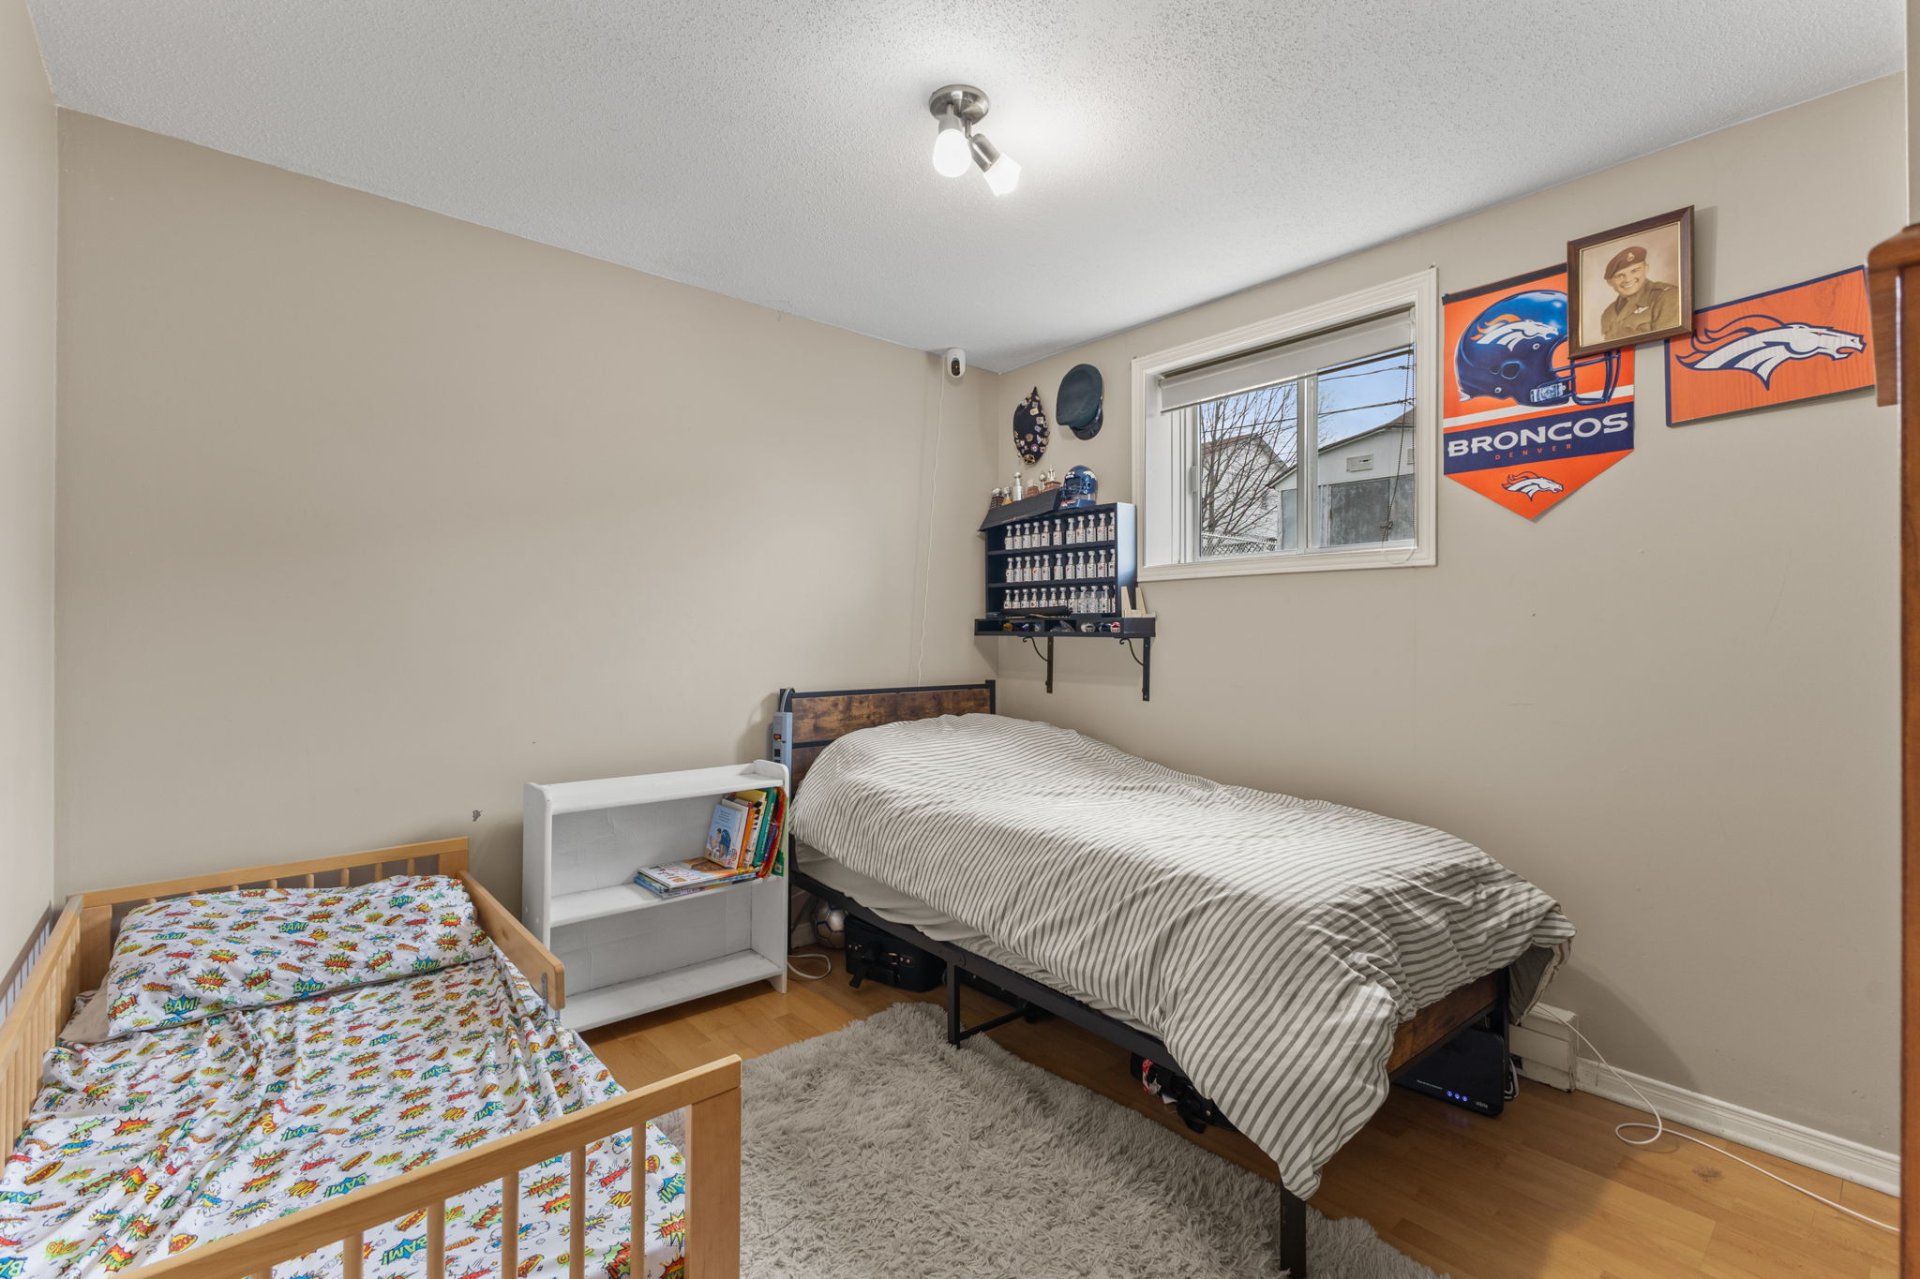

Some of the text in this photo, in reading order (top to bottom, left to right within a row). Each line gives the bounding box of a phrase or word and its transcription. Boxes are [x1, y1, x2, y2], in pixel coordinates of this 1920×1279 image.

[1448, 412, 1629, 457] BRONCOS
[1494, 443, 1573, 461] DENVER
[280, 922, 309, 933] BAM!
[293, 981, 326, 993] BAM!
[164, 997, 200, 1013] BAM!
[323, 1174, 369, 1198] BAM!
[608, 1193, 632, 1208] OW
[380, 1236, 428, 1266] BAM!
